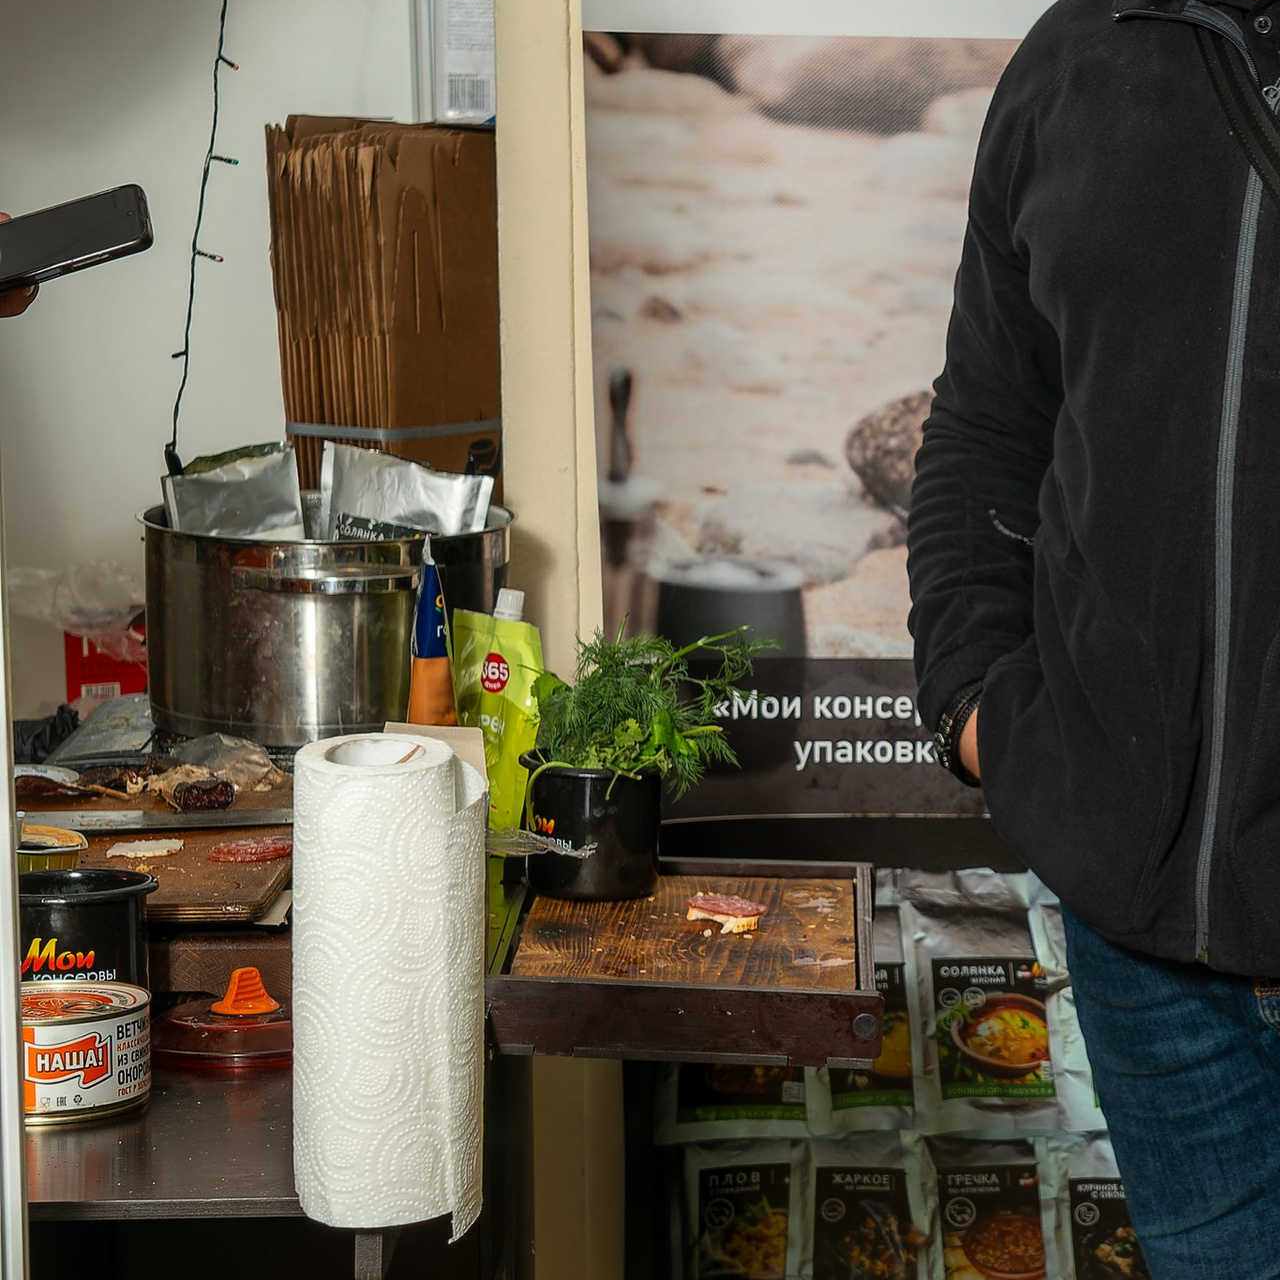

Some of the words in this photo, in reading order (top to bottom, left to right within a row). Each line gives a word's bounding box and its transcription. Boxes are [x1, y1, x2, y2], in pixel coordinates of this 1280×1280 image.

[813, 693, 923, 728] консе
[793, 740, 938, 772] упаковк
[20, 937, 96, 974] Мои
[939, 965, 1006, 979] СОЛЯНКА
[35, 1047, 104, 1073] НАША!
[707, 1171, 761, 1188] ПЛОВ
[831, 1172, 891, 1185] ЖАРКОЕ
[946, 1172, 1001, 1186] ГРЕЧКА
